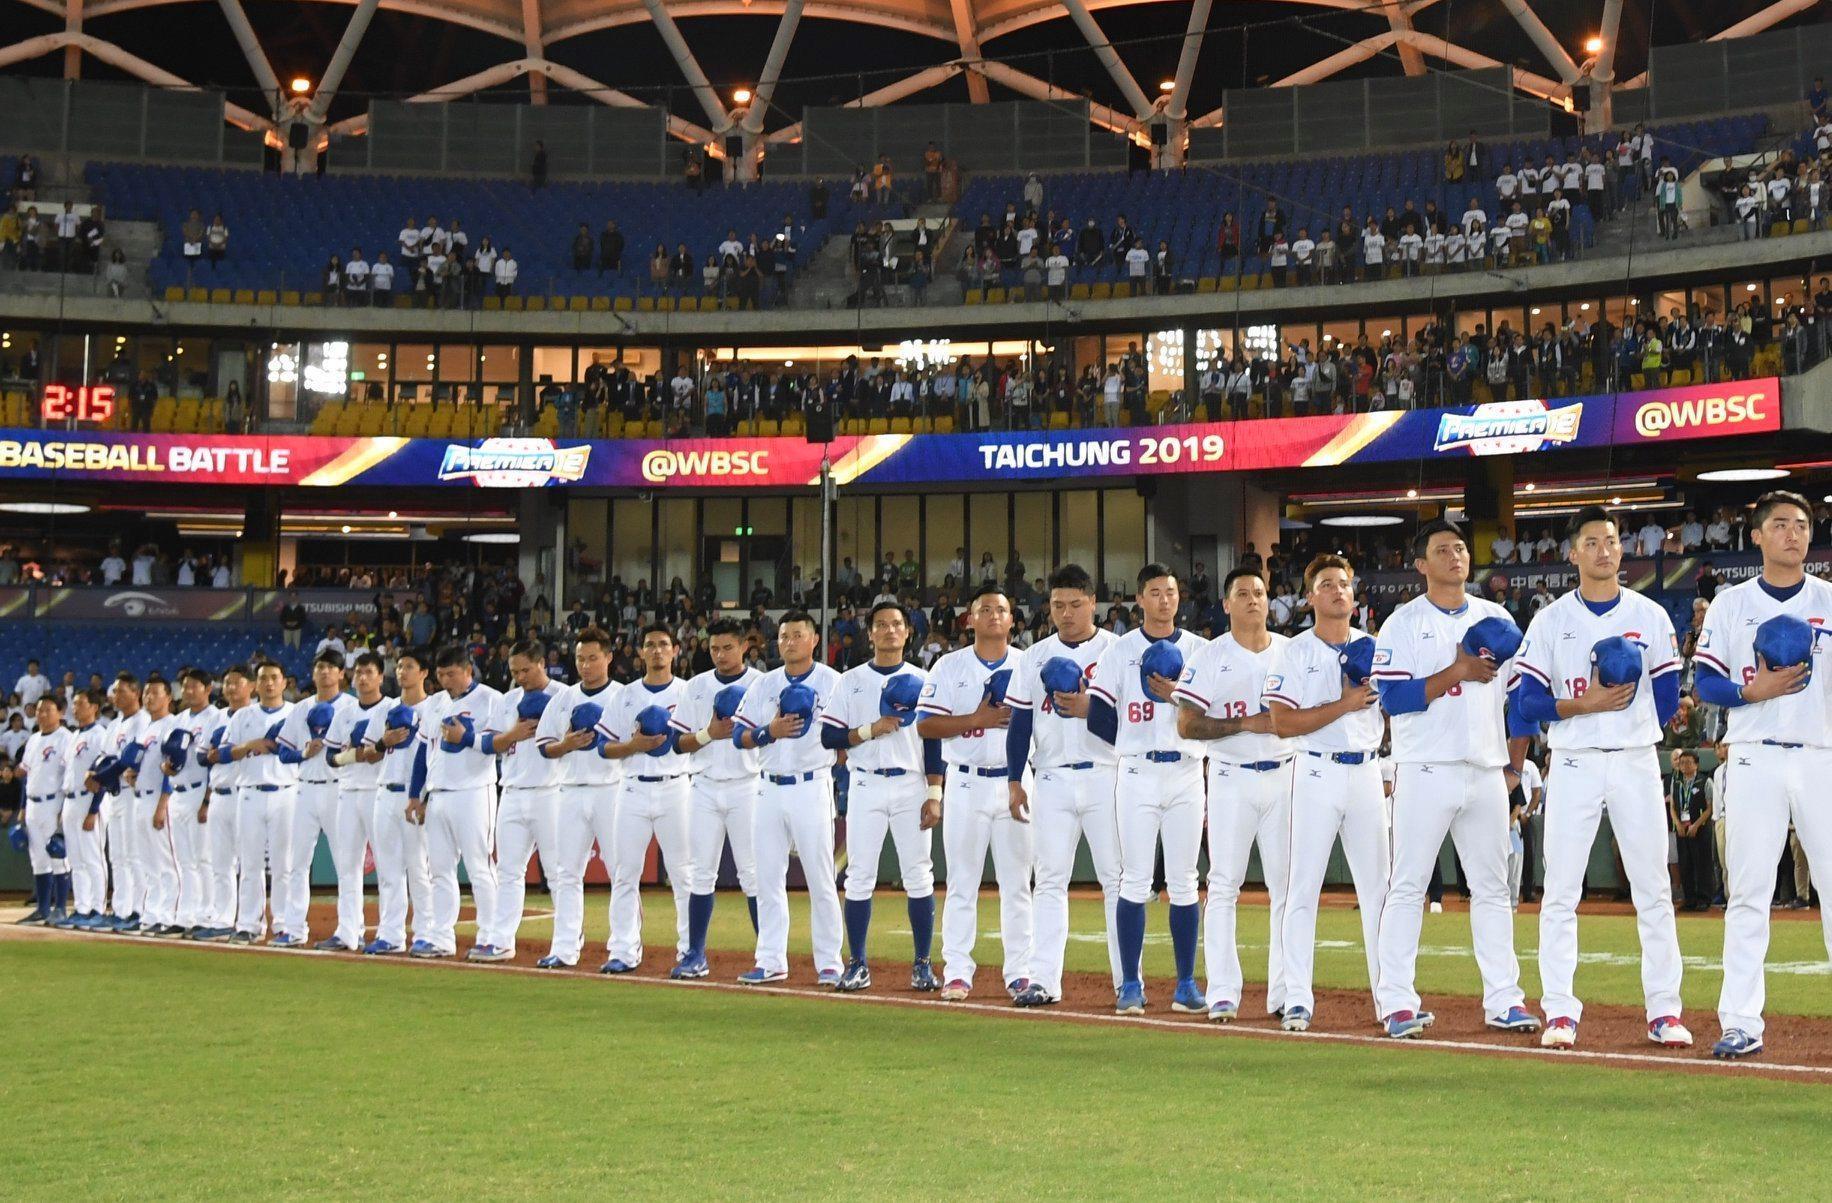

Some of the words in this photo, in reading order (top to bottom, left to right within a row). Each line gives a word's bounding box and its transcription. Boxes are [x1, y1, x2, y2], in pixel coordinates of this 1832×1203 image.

[42, 385, 115, 421] 2:15
[1635, 393, 1766, 437] @WBSC
[0, 440, 165, 472] BASEBALL
[168, 446, 290, 474] BATTLE
[642, 449, 769, 482] @WBSC
[978, 440, 1131, 469] TAICHUNG
[1138, 435, 1224, 465] 2019
[1564, 677, 1588, 698] 18
[1128, 701, 1155, 723] 69
[1223, 700, 1247, 719] 13
